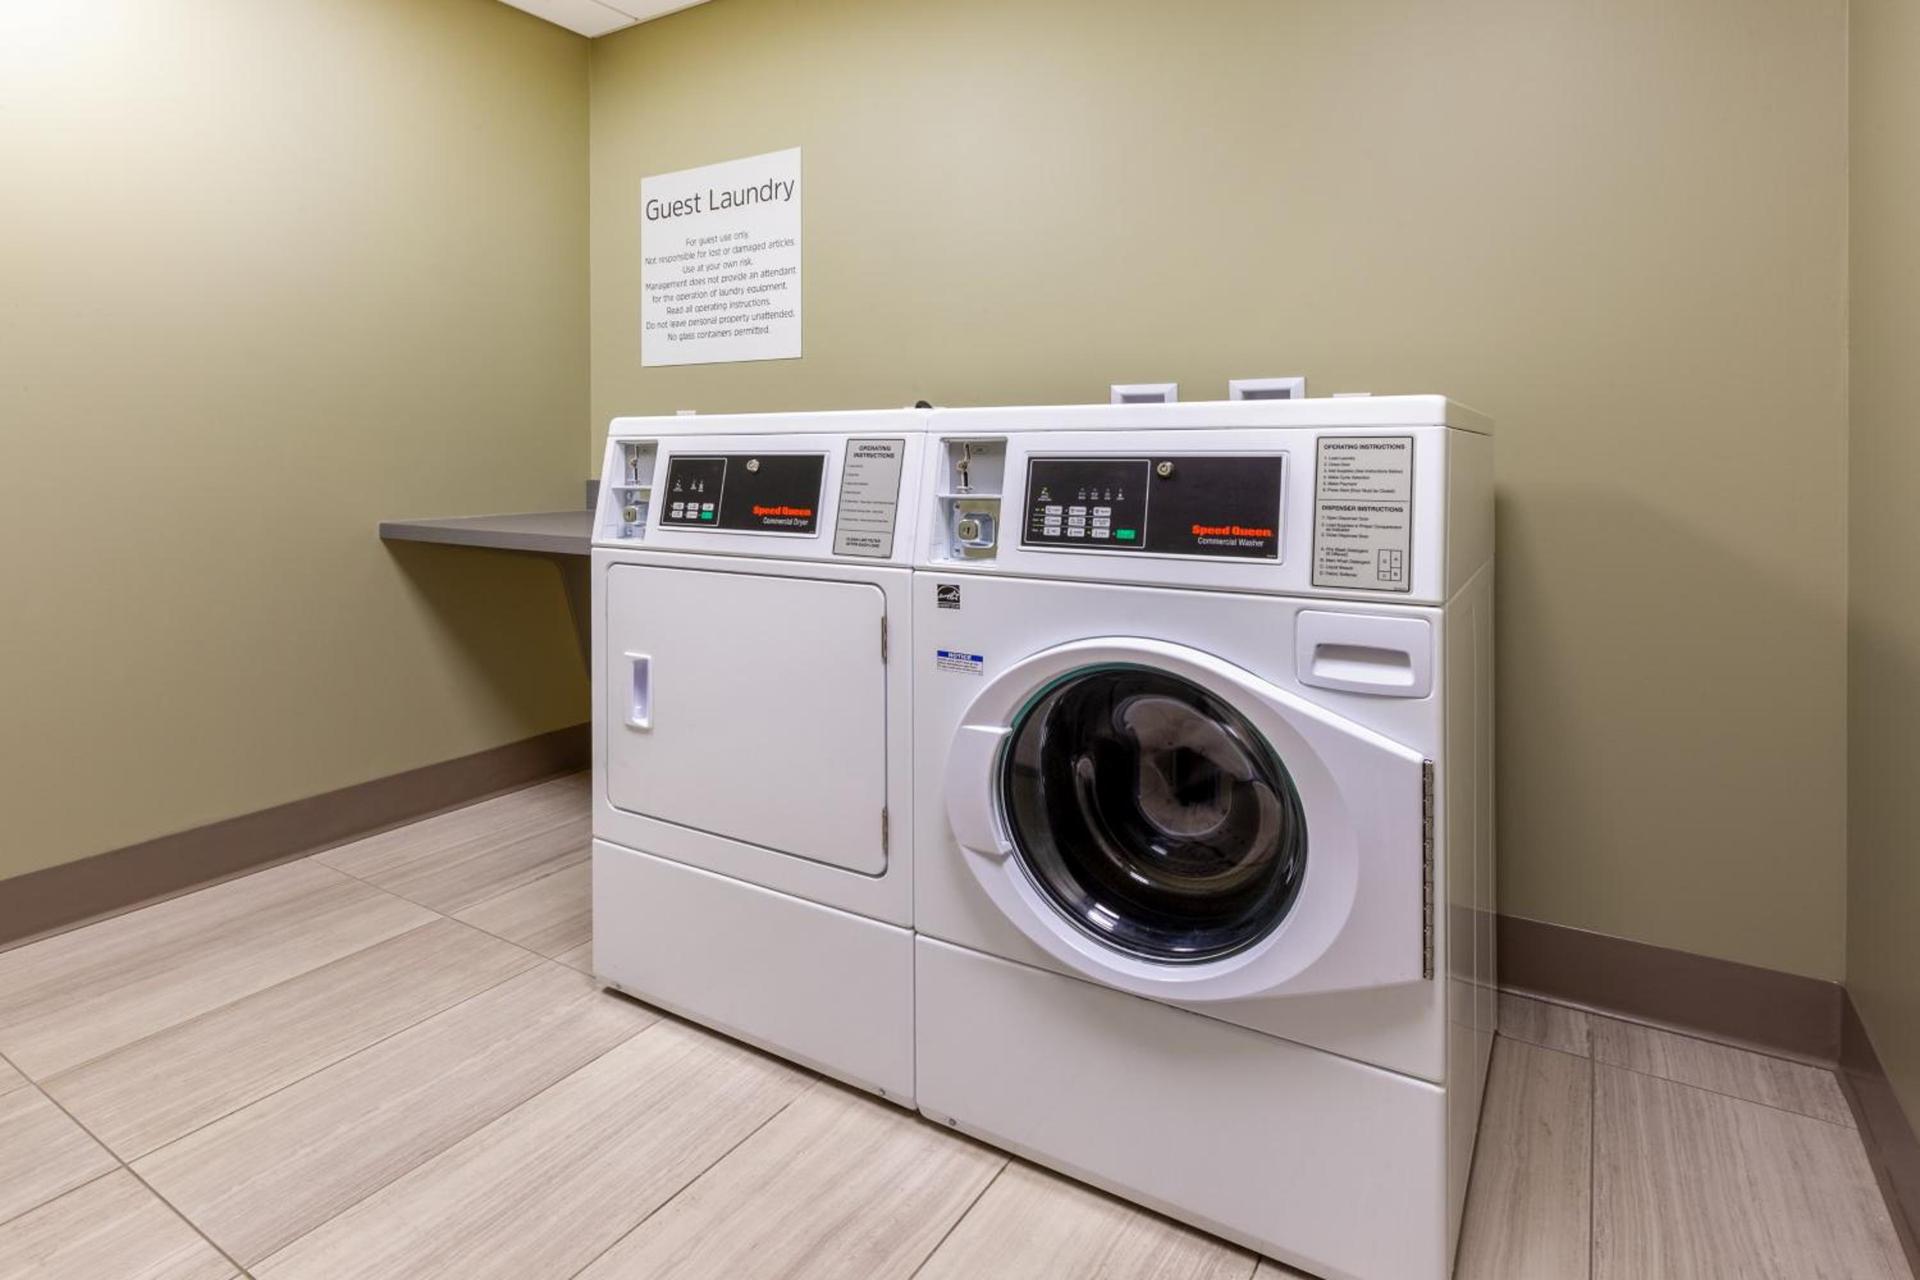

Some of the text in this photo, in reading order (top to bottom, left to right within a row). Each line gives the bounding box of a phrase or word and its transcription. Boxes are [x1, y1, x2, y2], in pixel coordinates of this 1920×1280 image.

[646, 178, 795, 221] Guest Laundry
[686, 238, 697, 247] For
[699, 236, 718, 246] guest
[720, 234, 732, 242] use
[645, 256, 657, 265] Not
[659, 251, 696, 264] responsible
[697, 250, 707, 259] for
[709, 248, 722, 257] lost
[723, 247, 731, 256] or
[732, 242, 767, 255] damaged
[682, 257, 753, 274] Use at your own risk.
[646, 266, 796, 291] Management does not provide an attendant
[652, 281, 788, 304] for the operation of laundry equipment.
[666, 306, 684, 315] Read
[685, 304, 693, 313] all
[695, 302, 728, 314] operating
[646, 321, 656, 330] Do
[657, 320, 668, 328] not
[669, 319, 687, 328] leave
[688, 316, 717, 327] personal
[718, 313, 750, 325] property
[667, 333, 677, 341] No
[678, 331, 695, 342] glass
[697, 329, 732, 339] containers
[752, 505, 812, 517] Speed Queen
[763, 517, 809, 527] Commercial Dryer
[1192, 525, 1272, 537] Speed Queen
[1198, 537, 1264, 547] Commercial Washer
[948, 651, 971, 660] NOTICE
